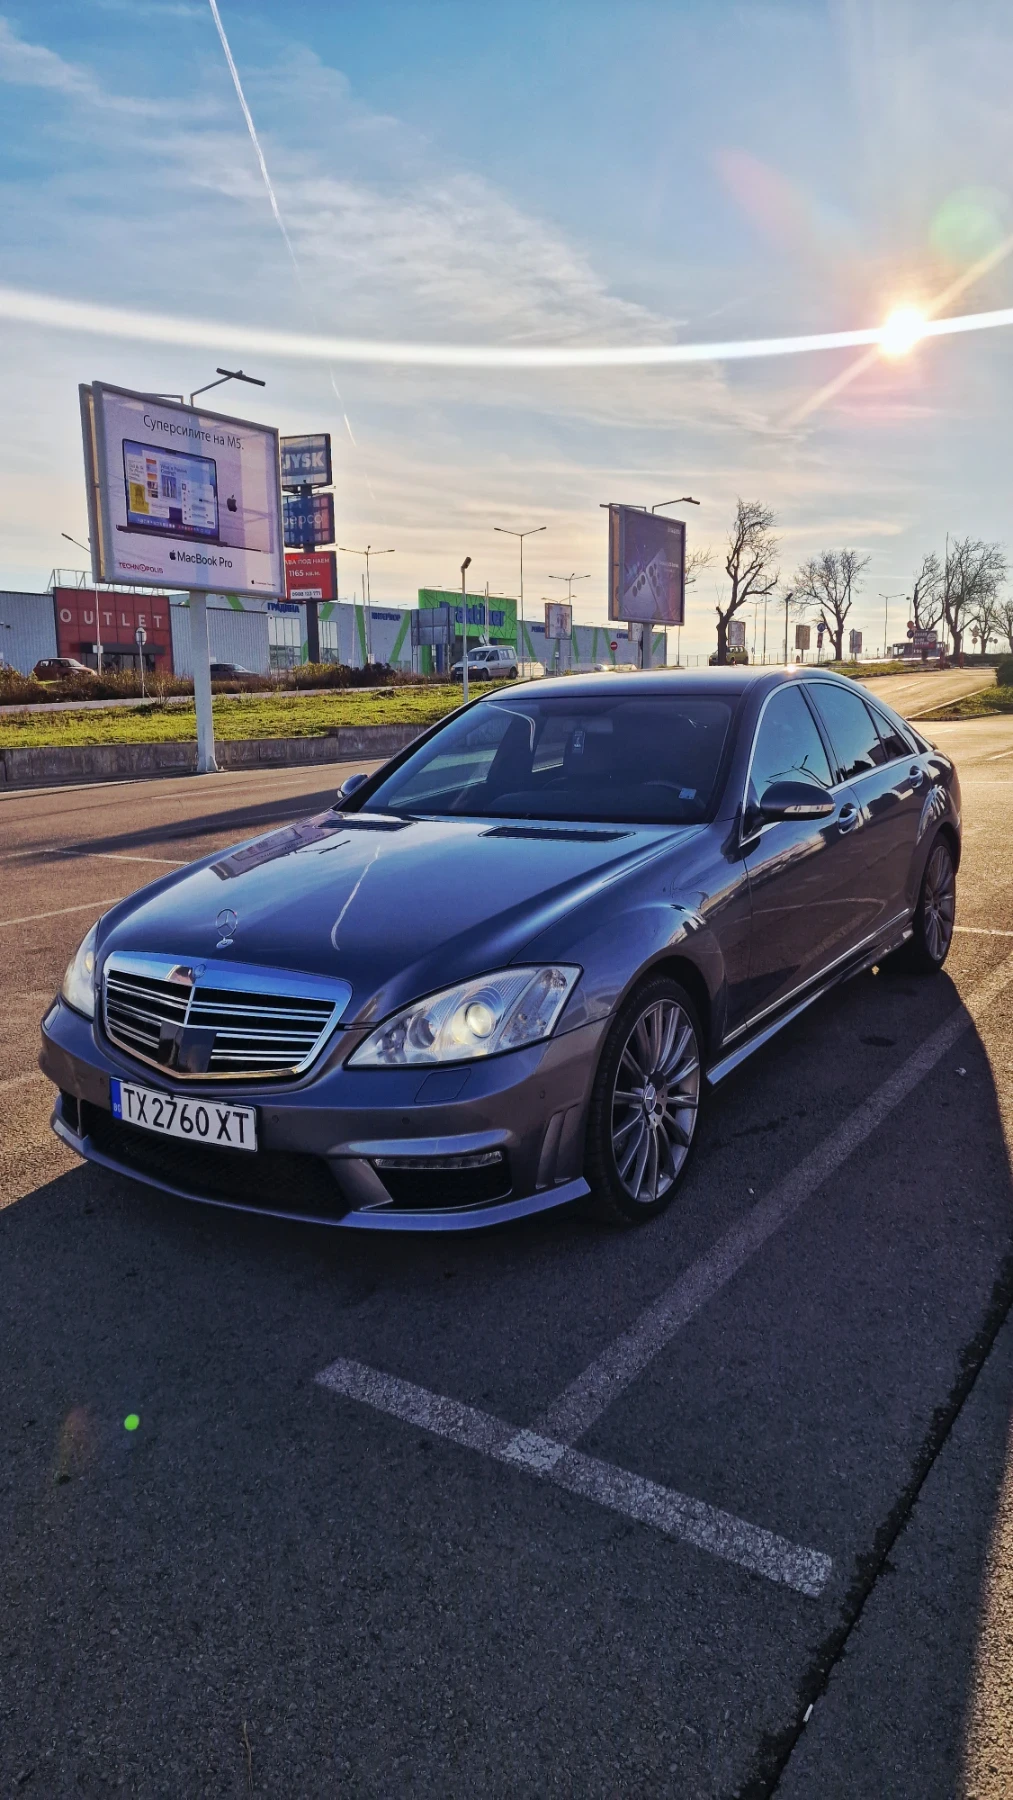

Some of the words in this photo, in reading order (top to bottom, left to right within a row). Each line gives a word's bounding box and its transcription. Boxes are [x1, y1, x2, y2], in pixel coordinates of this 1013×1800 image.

[143, 414, 211, 442] Суперсилите
[213, 434, 225, 446] на
[282, 451, 324, 469] JYSK
[177, 550, 217, 567] MacBook
[219, 556, 233, 568] Pro
[60, 608, 162, 628] OUTLET
[123, 1087, 148, 1124] TX
[151, 1097, 210, 1137] 2760
[215, 1108, 249, 1144] XT
